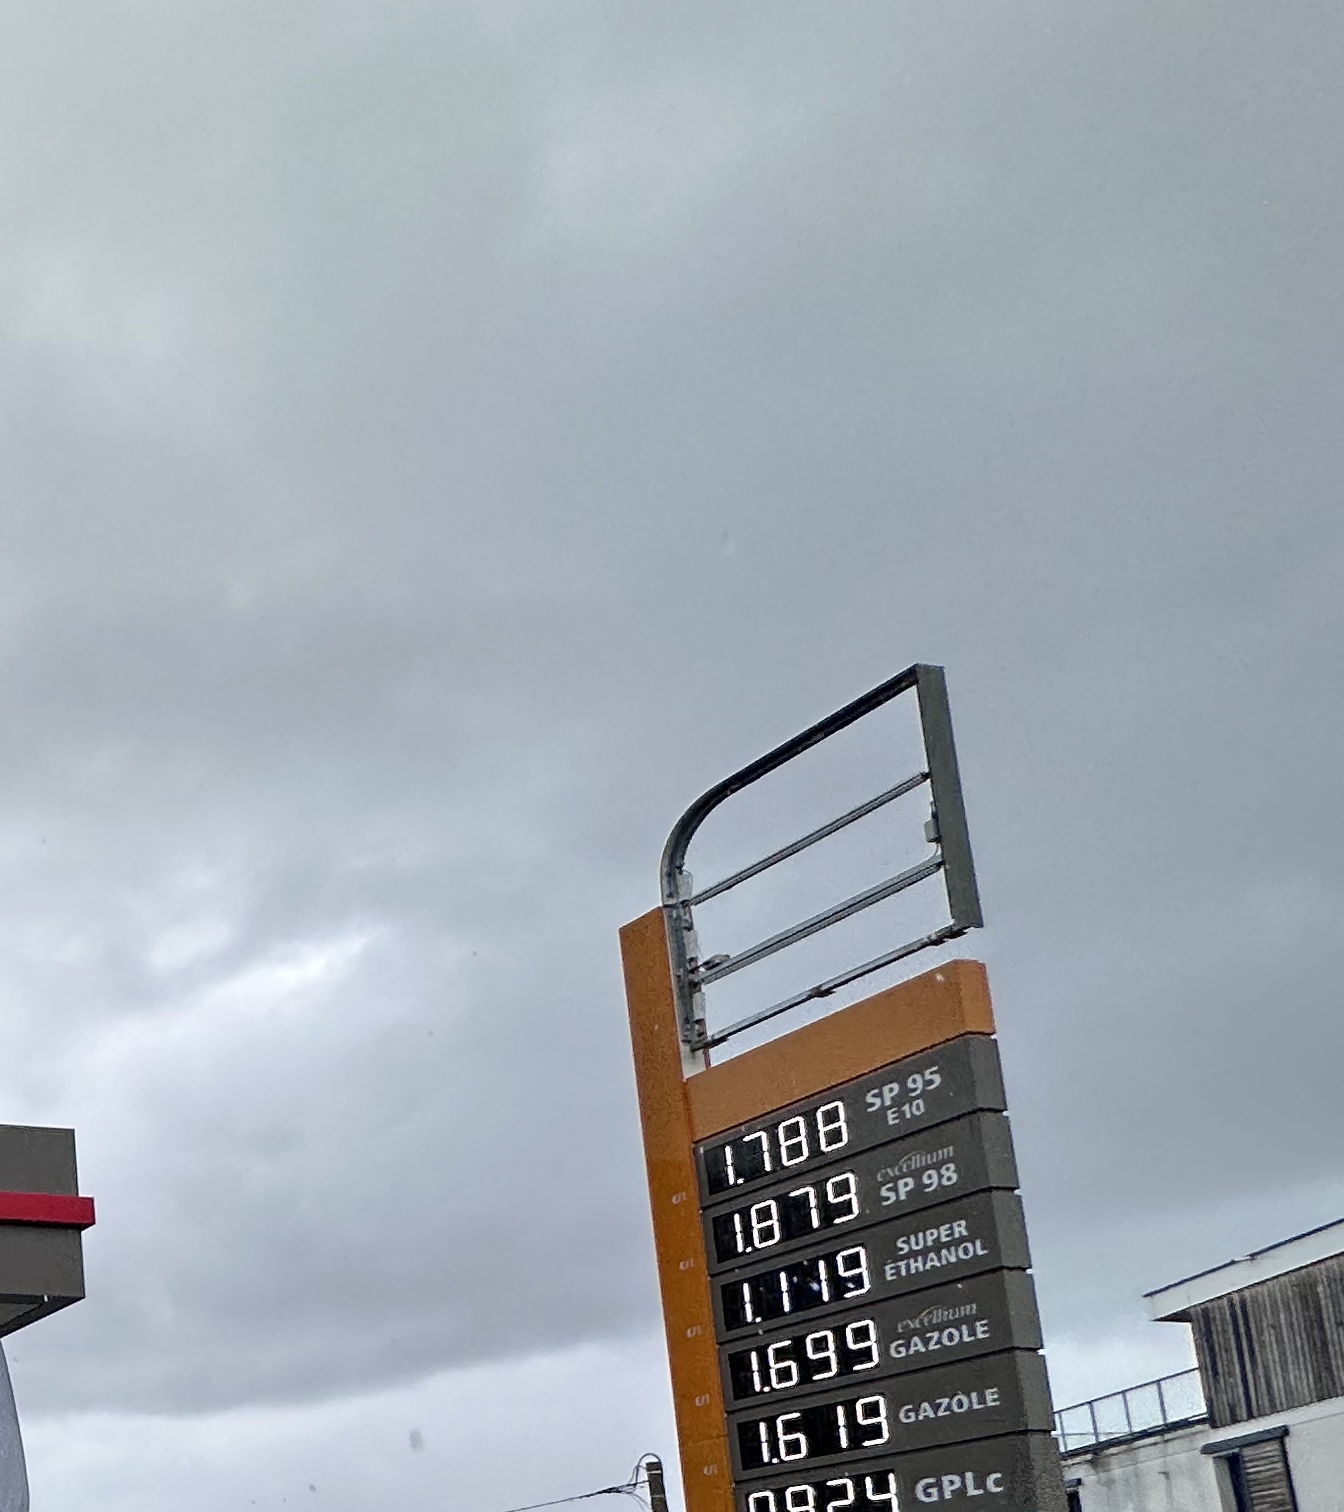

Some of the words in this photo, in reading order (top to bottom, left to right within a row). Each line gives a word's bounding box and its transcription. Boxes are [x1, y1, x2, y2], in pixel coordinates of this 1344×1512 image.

[865, 1082, 900, 1112] SP
[907, 1065, 942, 1097] 95
[886, 1098, 925, 1125] E10
[725, 1101, 849, 1186] 1.788
[877, 1145, 954, 1181] excellium
[879, 1176, 914, 1206] SP
[922, 1163, 958, 1193] 98
[734, 1172, 860, 1253] 1.879
[896, 1219, 969, 1255] SUPER
[884, 1238, 989, 1281] ÉTHANOL
[742, 1246, 872, 1323] 1.119
[889, 1318, 991, 1359] GAZOLE
[897, 1303, 977, 1334] excellium
[750, 1319, 880, 1393] 1.699
[759, 1395, 890, 1464] 1.619
[914, 1471, 1005, 1503] GPLc
